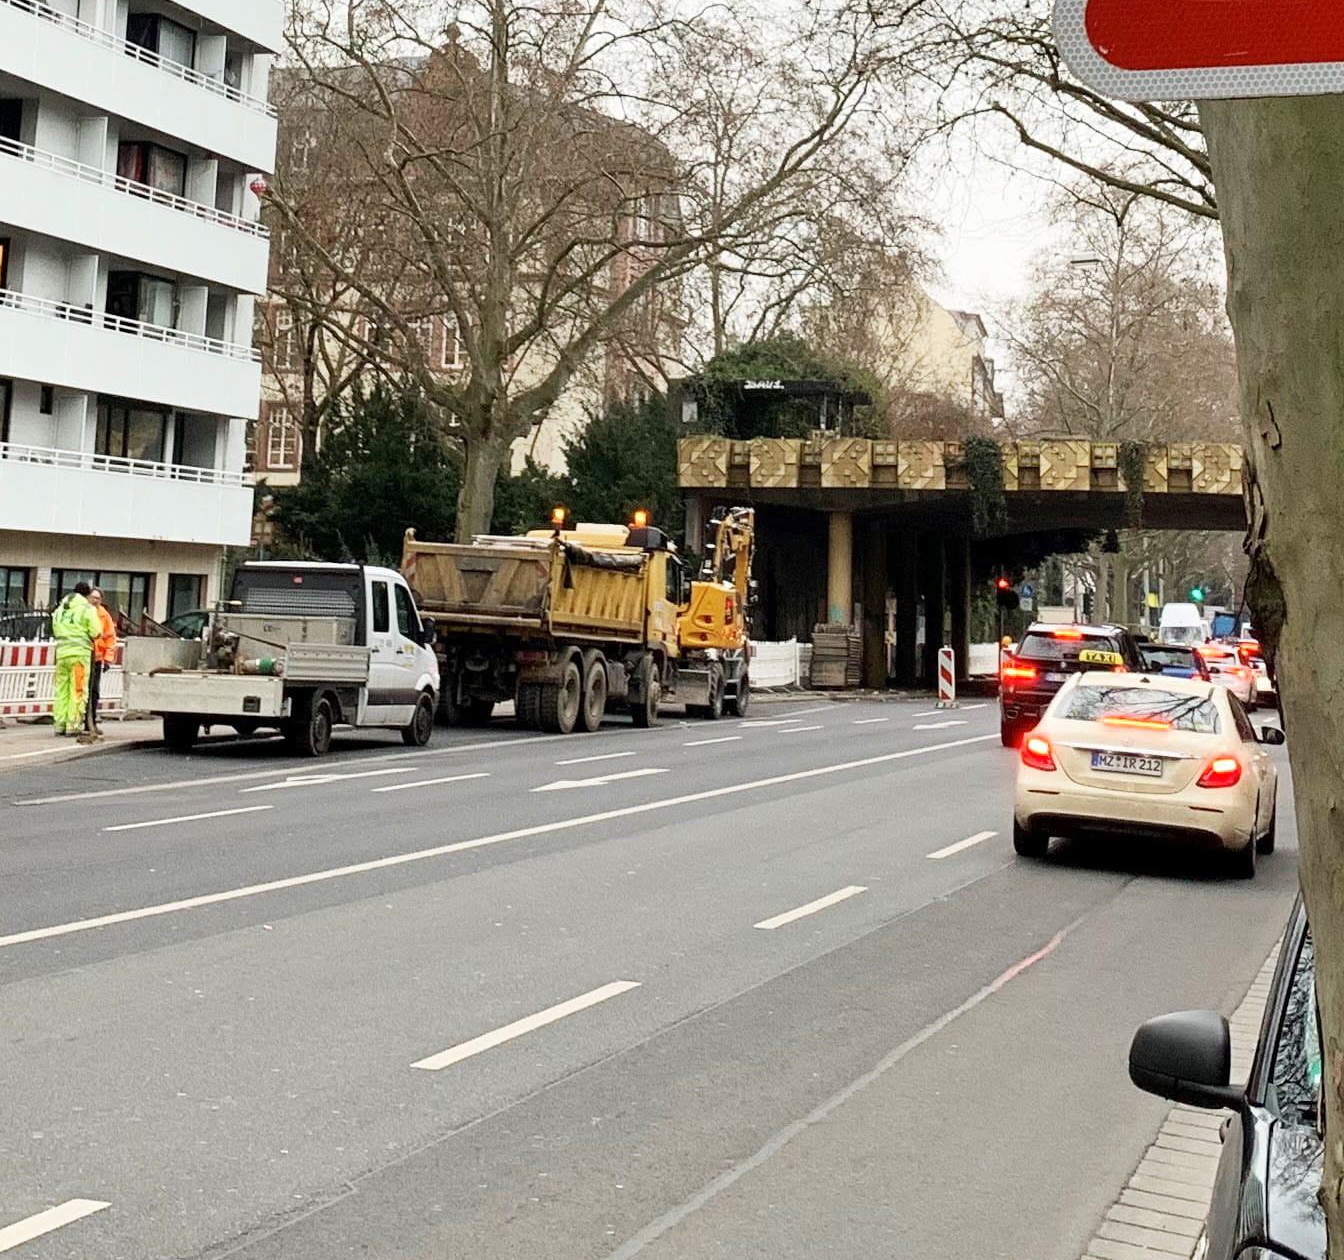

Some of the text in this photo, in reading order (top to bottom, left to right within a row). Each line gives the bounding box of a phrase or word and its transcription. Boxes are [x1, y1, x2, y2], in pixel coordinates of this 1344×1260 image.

[1086, 651, 1116, 663] TAXI
[1099, 755, 1114, 767] MZ
[1139, 760, 1161, 772] 212
